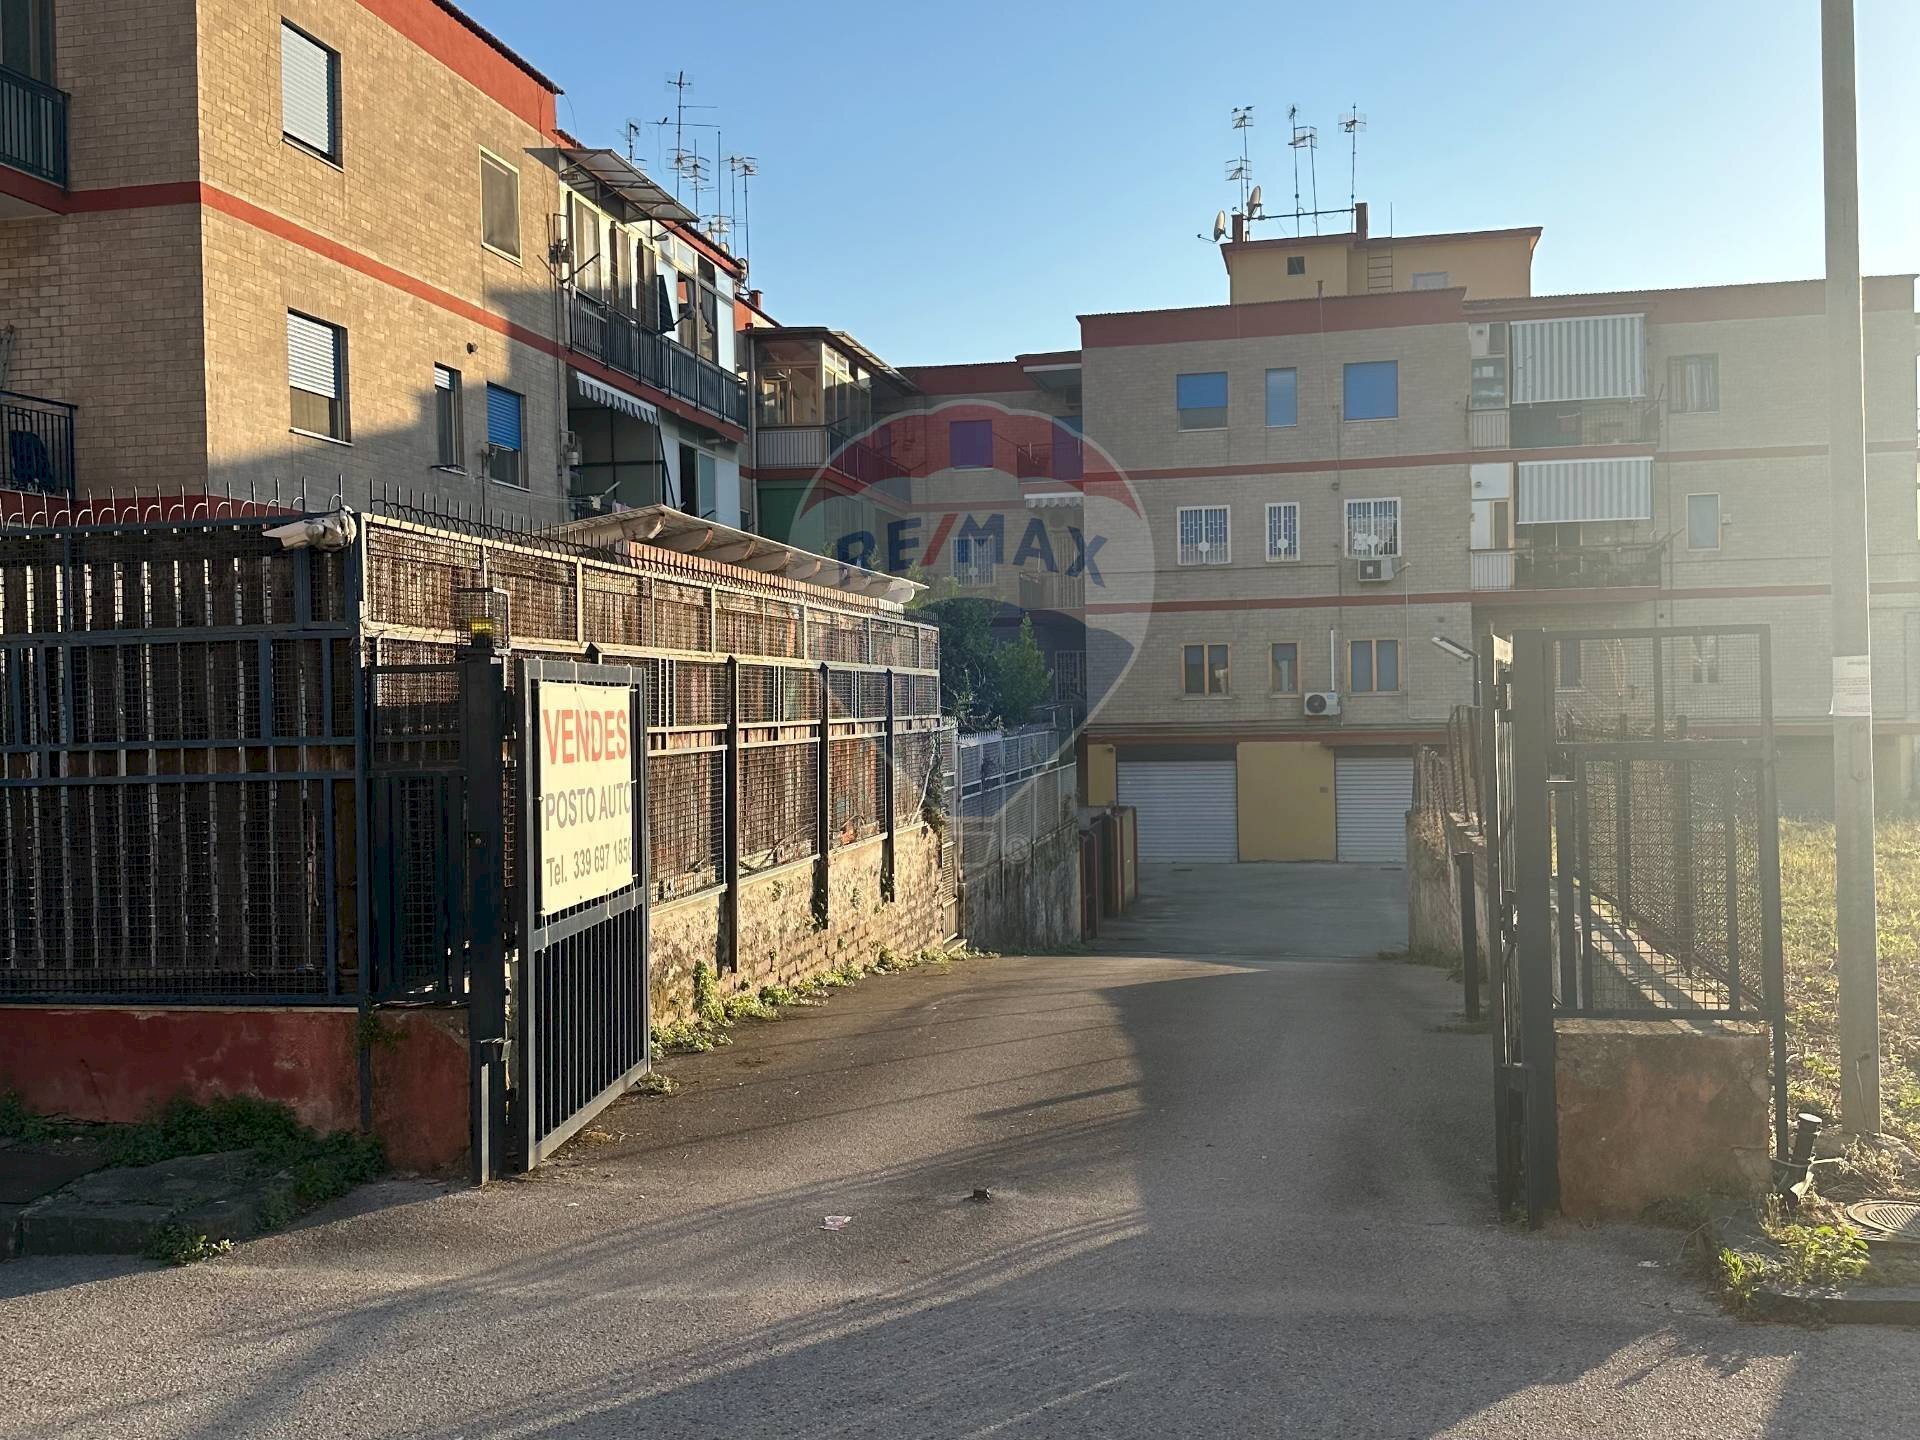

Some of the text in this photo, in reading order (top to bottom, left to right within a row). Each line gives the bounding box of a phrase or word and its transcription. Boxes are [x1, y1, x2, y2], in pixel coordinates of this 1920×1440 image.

[543, 709, 629, 765] VENDES
[545, 786, 596, 831] POSTO
[546, 855, 568, 887] Tel.
[574, 848, 592, 880] 339
[594, 843, 610, 871] 697
